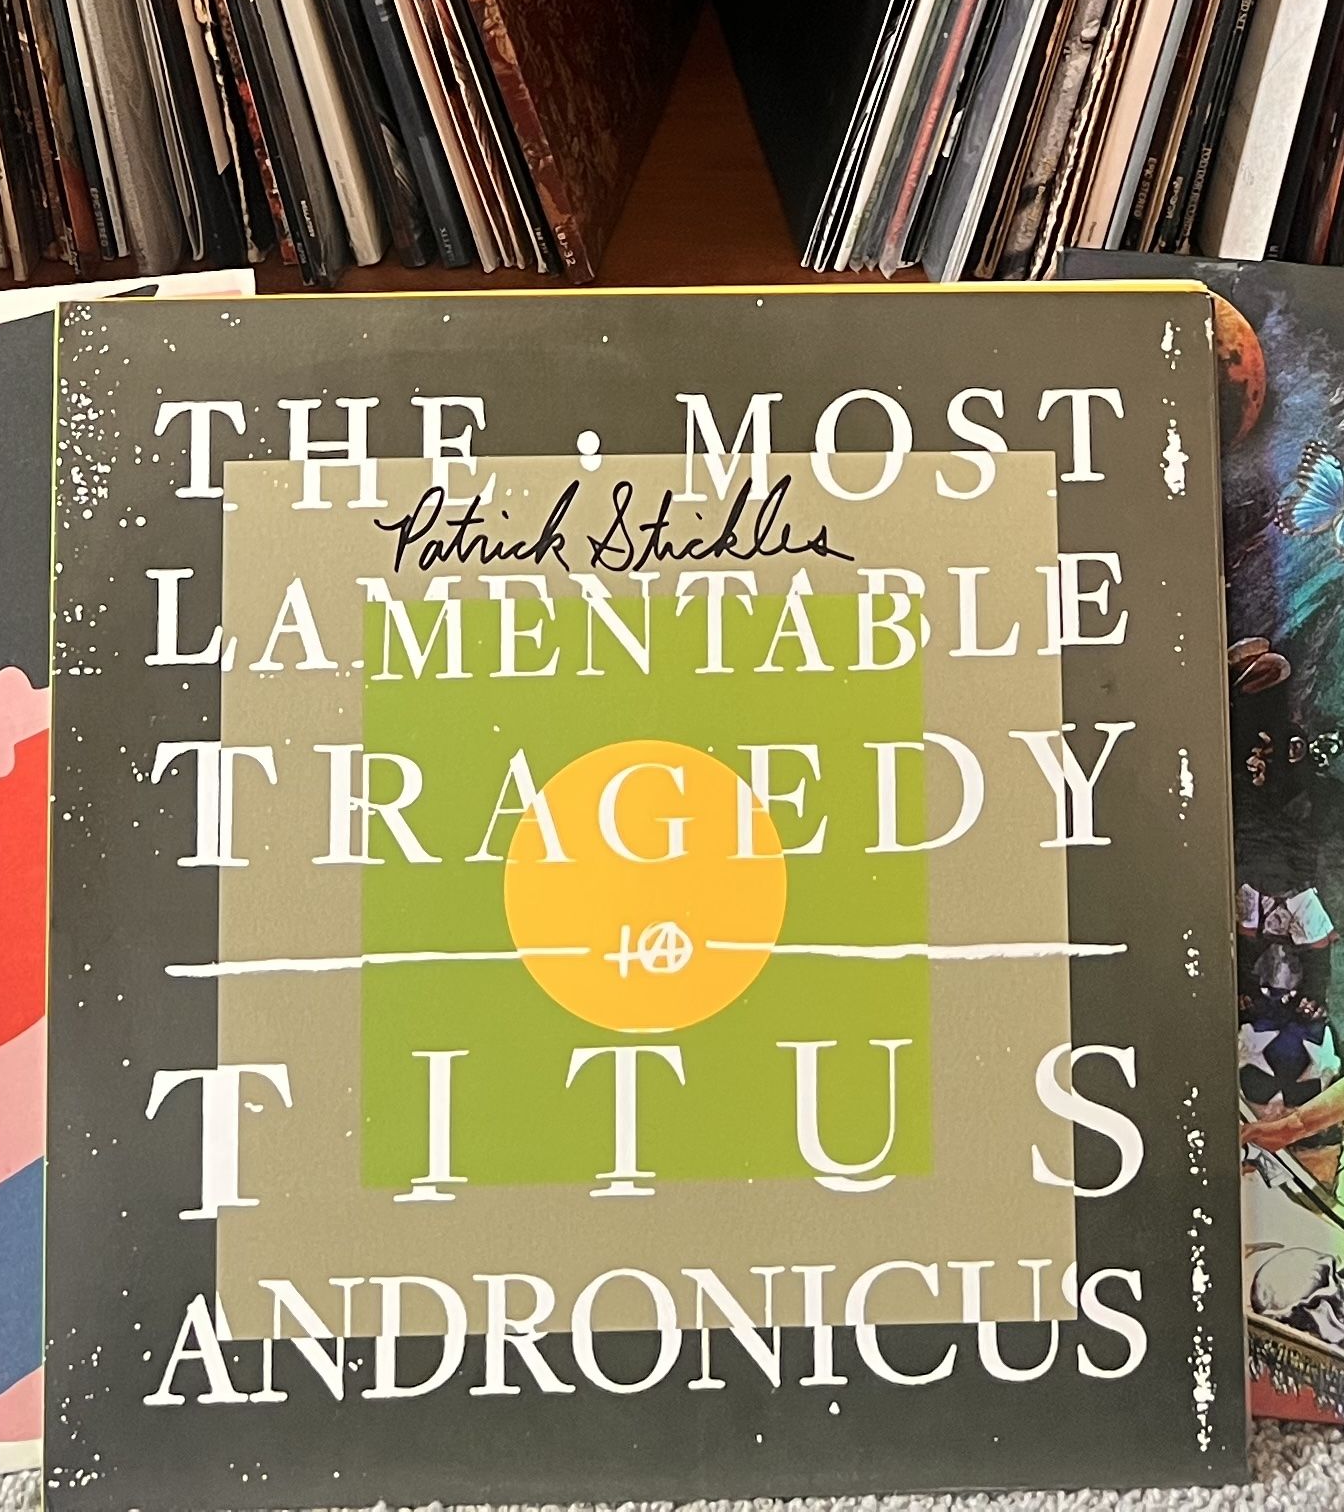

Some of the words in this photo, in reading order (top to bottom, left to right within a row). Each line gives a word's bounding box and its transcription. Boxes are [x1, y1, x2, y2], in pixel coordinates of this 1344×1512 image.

[1234, 11, 1247, 31] SET
[88, 186, 101, 210] EPIC
[1132, 180, 1151, 218] STEREO
[1143, 155, 1157, 179] EPIC
[93, 209, 109, 248] STEREO
[553, 223, 576, 267] LBJ-32
[154, 393, 502, 512] THE
[675, 386, 1126, 502] MOST
[373, 479, 582, 576] Patrick
[586, 474, 855, 575] Stickles
[144, 550, 1130, 684] LAMENTABLE
[149, 720, 1138, 870] TRAGEDY
[142, 1035, 1146, 1223] TITUS
[142, 1257, 1151, 1408] ANDRONICUS
